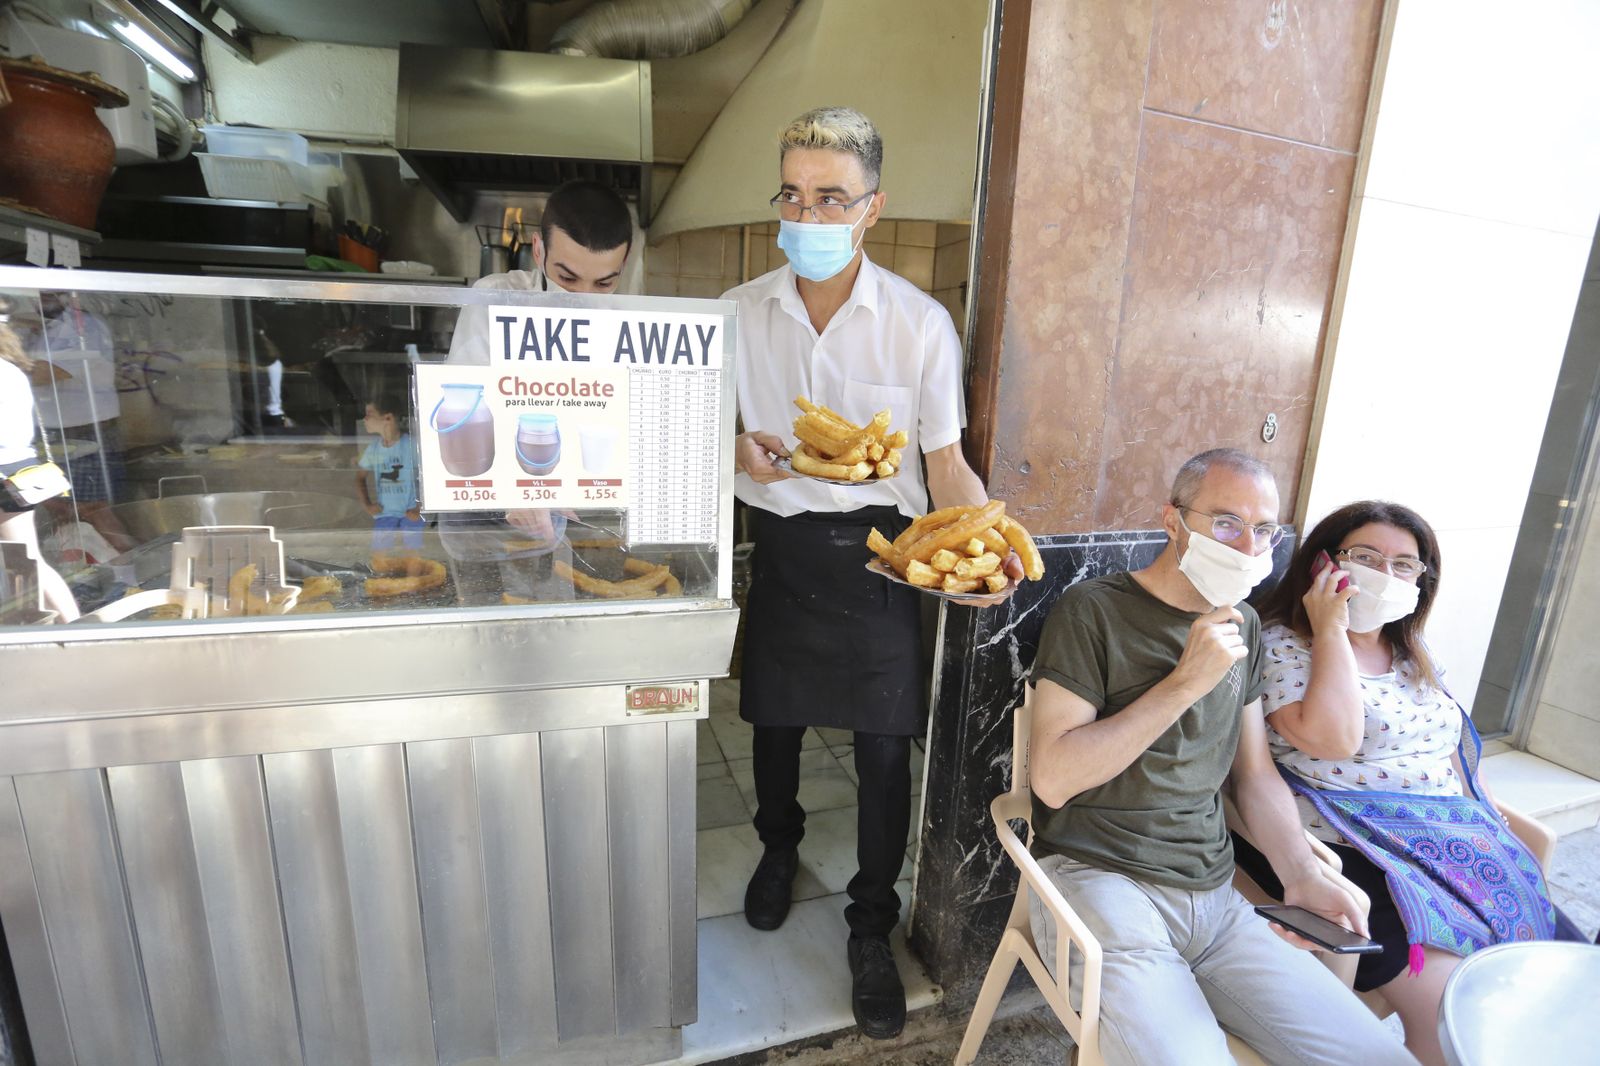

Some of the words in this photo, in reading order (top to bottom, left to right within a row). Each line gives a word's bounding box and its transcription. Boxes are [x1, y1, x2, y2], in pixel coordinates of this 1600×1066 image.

[496, 316, 590, 361] TAKE
[613, 321, 717, 366] AWAY
[498, 376, 614, 397] Chocolate
[506, 399, 526, 408] para
[528, 398, 554, 406] llevar
[562, 399, 582, 407] take
[584, 401, 606, 410] away
[453, 490, 496, 501] 10,50€
[523, 490, 556, 501] 5,30€
[584, 489, 617, 500] 1,55€
[632, 687, 693, 707] BRAUN
